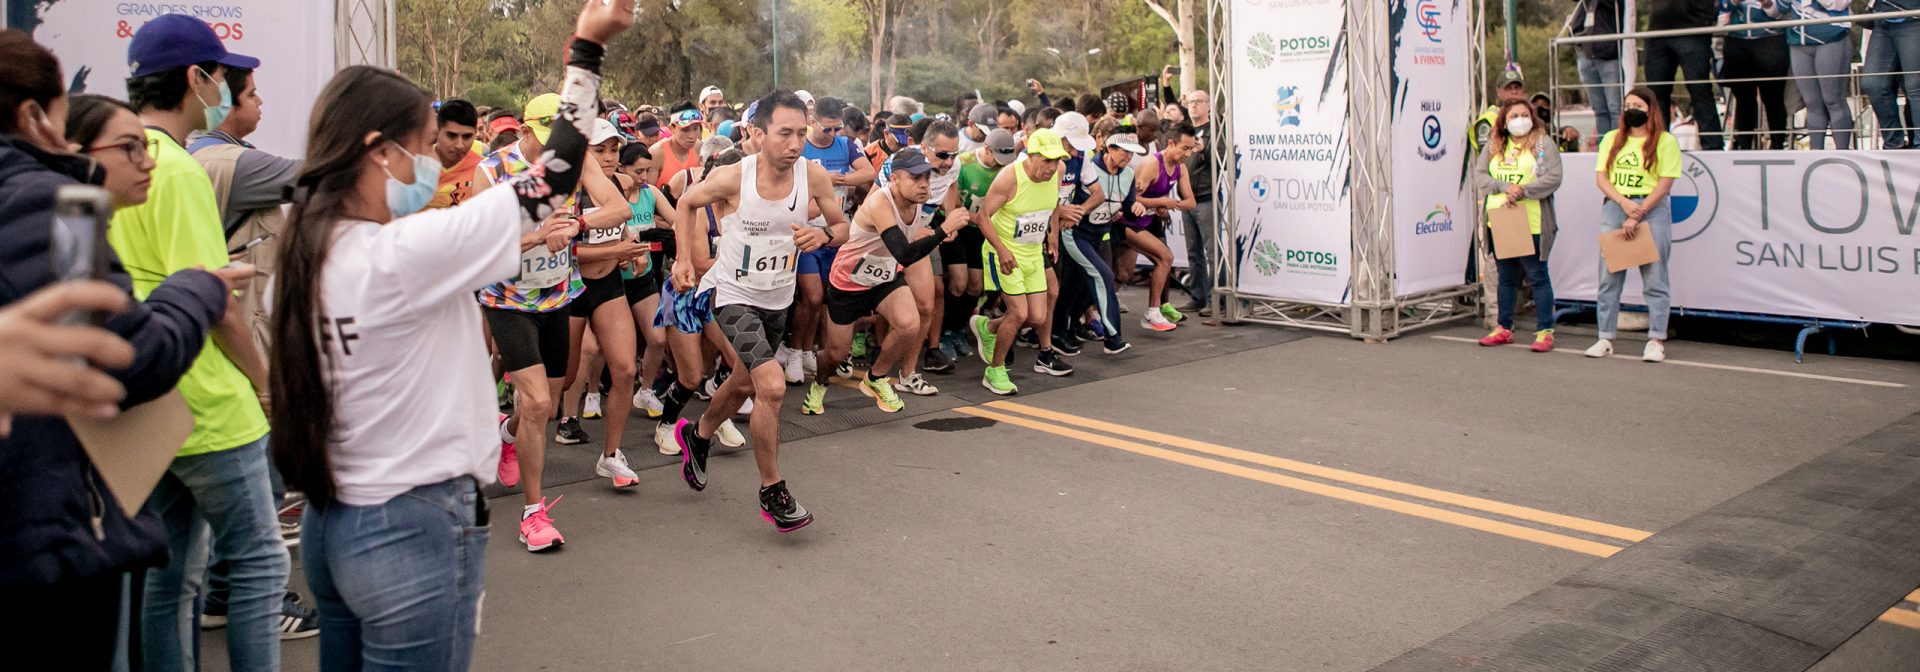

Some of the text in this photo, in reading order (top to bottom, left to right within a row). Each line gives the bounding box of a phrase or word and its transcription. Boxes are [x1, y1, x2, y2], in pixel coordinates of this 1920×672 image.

[116, 3, 243, 18] GRANDES SHOWS
[1249, 132, 1332, 145] BMW MARATÓN
[1250, 148, 1333, 161] TANGAMANGA
[1614, 172, 1644, 188] JUEZ
[1272, 178, 1336, 201] TOWN
[1273, 201, 1288, 209] SAN
[1289, 201, 1306, 211] LUIS
[1023, 222, 1045, 234] 986
[1415, 219, 1453, 235] Electrolit
[523, 251, 568, 273] 1280
[755, 254, 789, 272] 611
[1735, 240, 1805, 269] SAN
[1818, 243, 1899, 274] LUIS
[863, 264, 891, 281] 503
